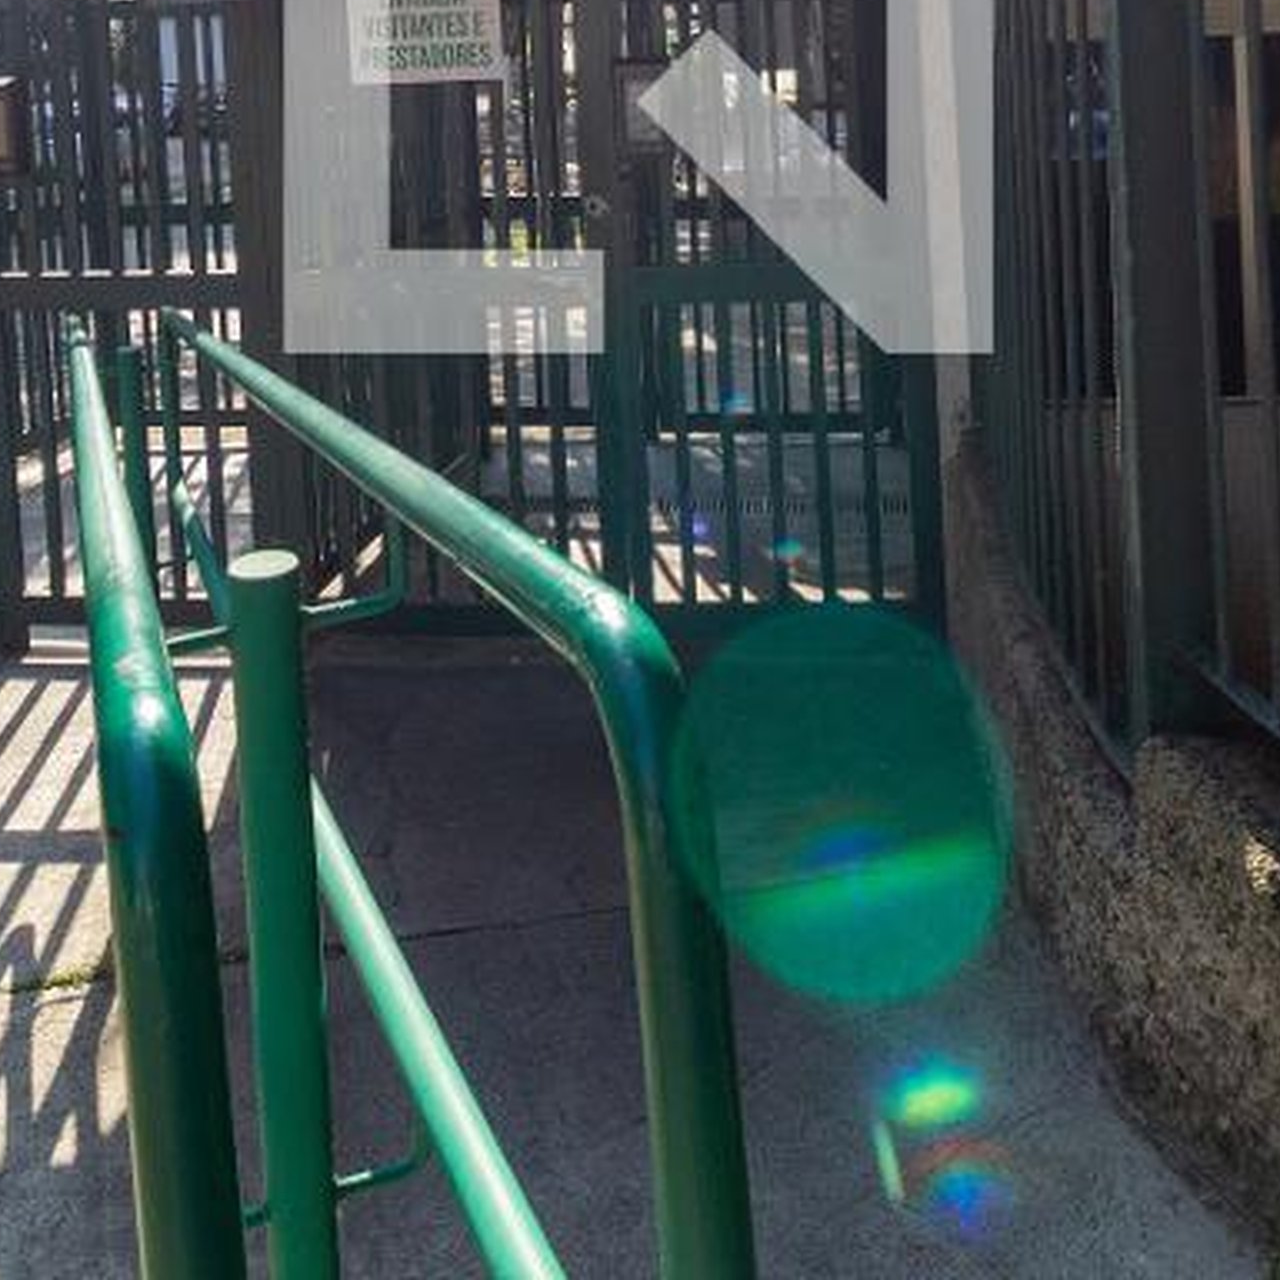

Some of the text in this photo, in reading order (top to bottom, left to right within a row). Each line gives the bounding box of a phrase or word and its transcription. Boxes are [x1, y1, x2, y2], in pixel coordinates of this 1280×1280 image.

[361, 11, 483, 39] VISITANTES E
[360, 42, 494, 70] PRESTADORES
